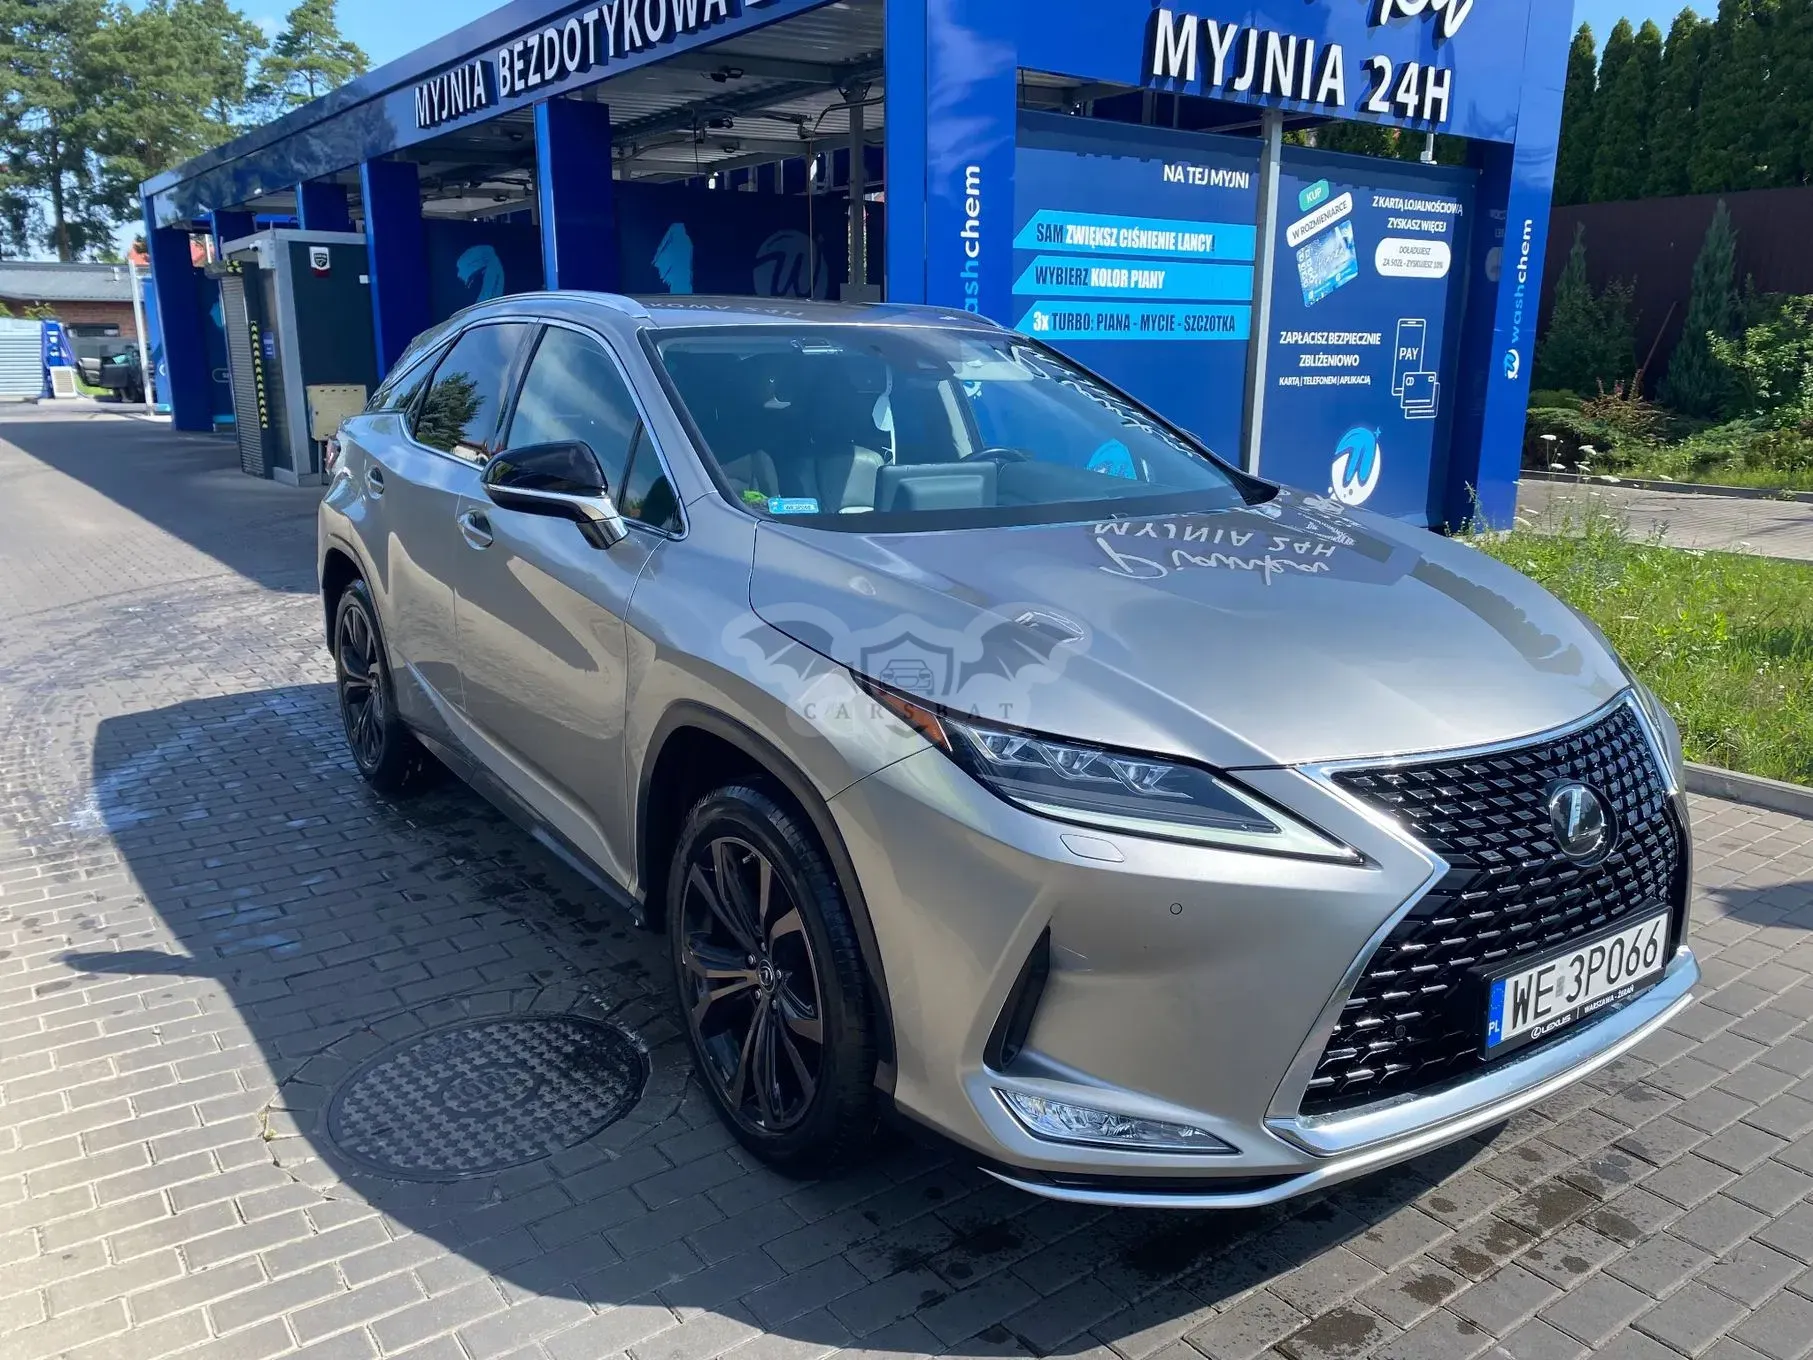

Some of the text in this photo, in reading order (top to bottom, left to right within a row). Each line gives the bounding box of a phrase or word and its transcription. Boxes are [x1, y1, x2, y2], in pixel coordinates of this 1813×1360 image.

[414, 0, 727, 128] MYJNIA BEZDOTYKOW
[1152, 8, 1345, 106] MYJNIA
[1366, 55, 1451, 123] 24H
[1163, 164, 1250, 189] NA TEJ MYJNI
[1305, 187, 1323, 203] KUP
[1372, 196, 1463, 217] Z KARTĄ LOJALNOŚCIOWĄ
[1300, 201, 1348, 236] ROZMIENIARCE
[1387, 217, 1447, 234] ZYSKASZ WIĘCEJ
[960, 165, 981, 314] ashchem
[1036, 222, 1064, 244] SAM
[1065, 224, 1118, 249] ZWIĘKSZ
[1119, 226, 1176, 251] CIŚNIENIE
[1035, 266, 1165, 289] WYBIERZ KOLOR PIANY
[1510, 218, 1533, 344] washchem
[1033, 311, 1049, 331] 3x
[1052, 312, 1094, 332] TURBO:
[1096, 313, 1131, 331] PIANA
[1140, 314, 1175, 332] MYCIE
[1184, 314, 1236, 332] SZCZOTKA
[1279, 331, 1382, 345] ZAPŁACISZ BEZPIECZNIE
[1299, 352, 1360, 367] ZBLIŻENIOWO
[1398, 347, 1419, 361] PAY
[1279, 375, 1300, 387] KARTĄ
[1303, 376, 1338, 386] TELEFONEM
[1488, 919, 1662, 1036] PL WE 3P066
[1541, 1014, 1571, 1034] LEXUS
[1584, 994, 1614, 1013] WARSZAWA
